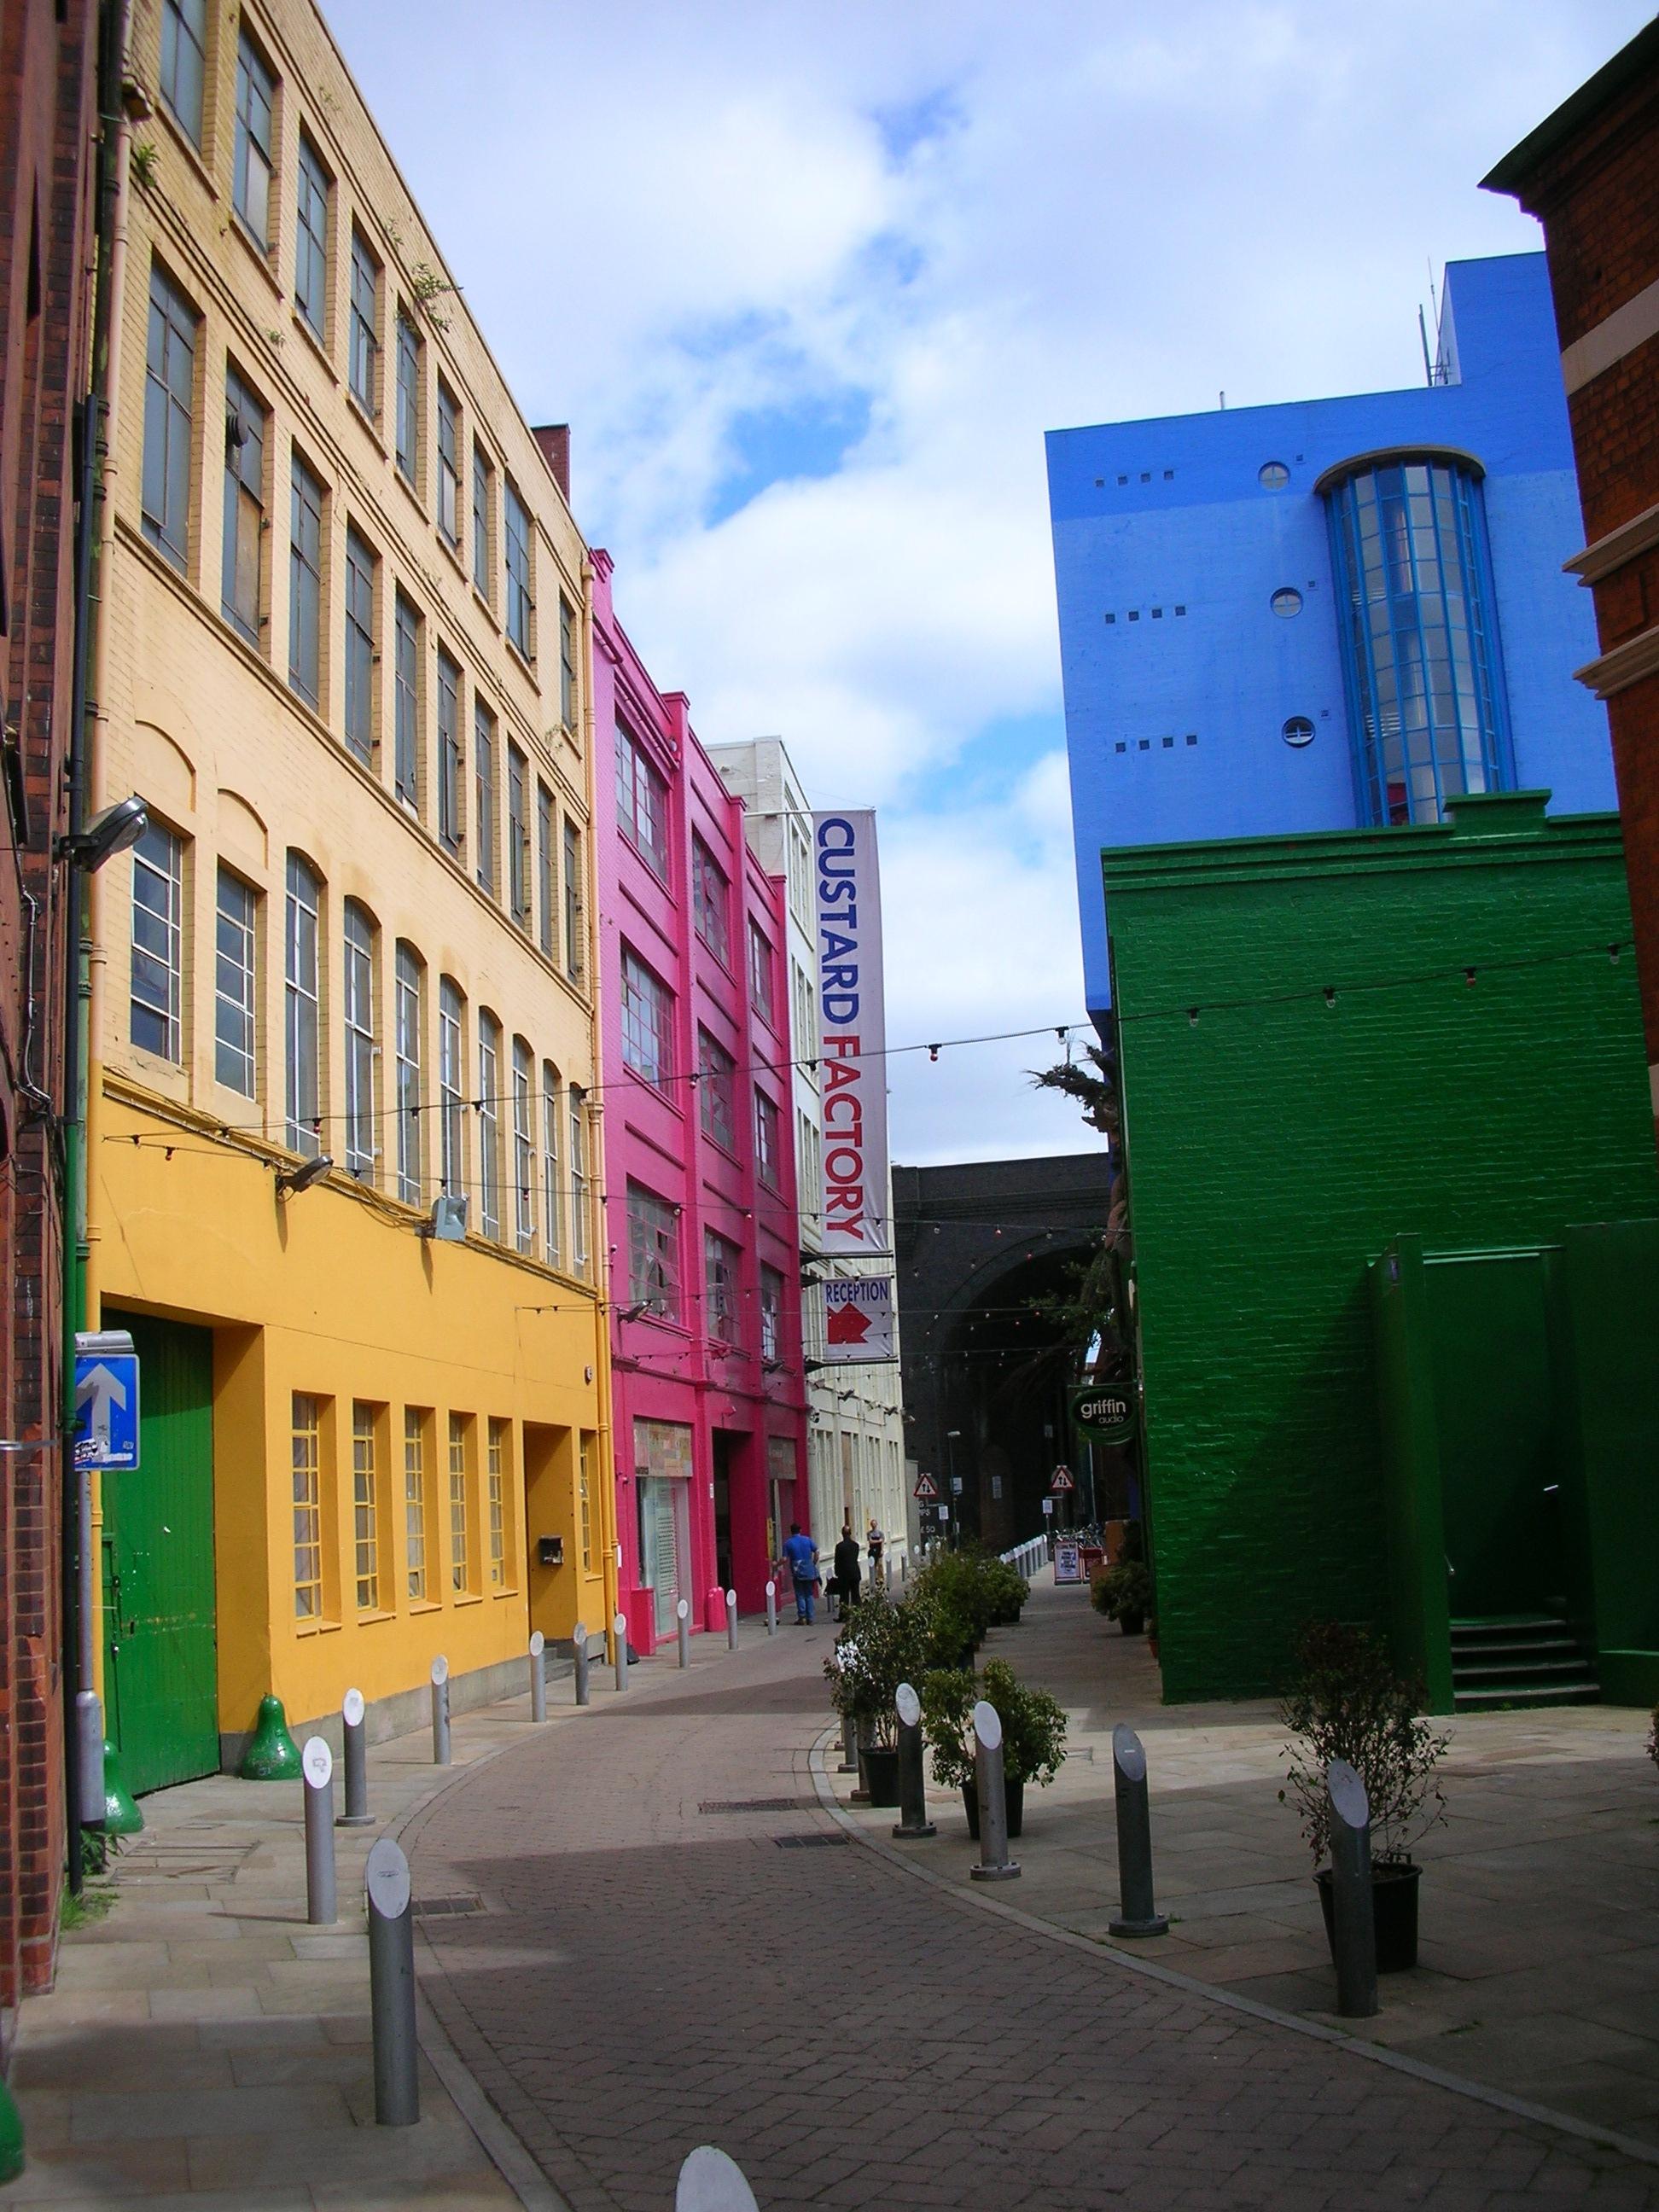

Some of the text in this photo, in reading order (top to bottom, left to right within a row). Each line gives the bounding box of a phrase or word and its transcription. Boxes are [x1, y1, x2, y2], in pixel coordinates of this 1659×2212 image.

[817, 818, 864, 1241] CUSTARD FACTORY
[825, 1280, 888, 1304] RECEPTION
[1080, 1399, 1126, 1419] griffin
